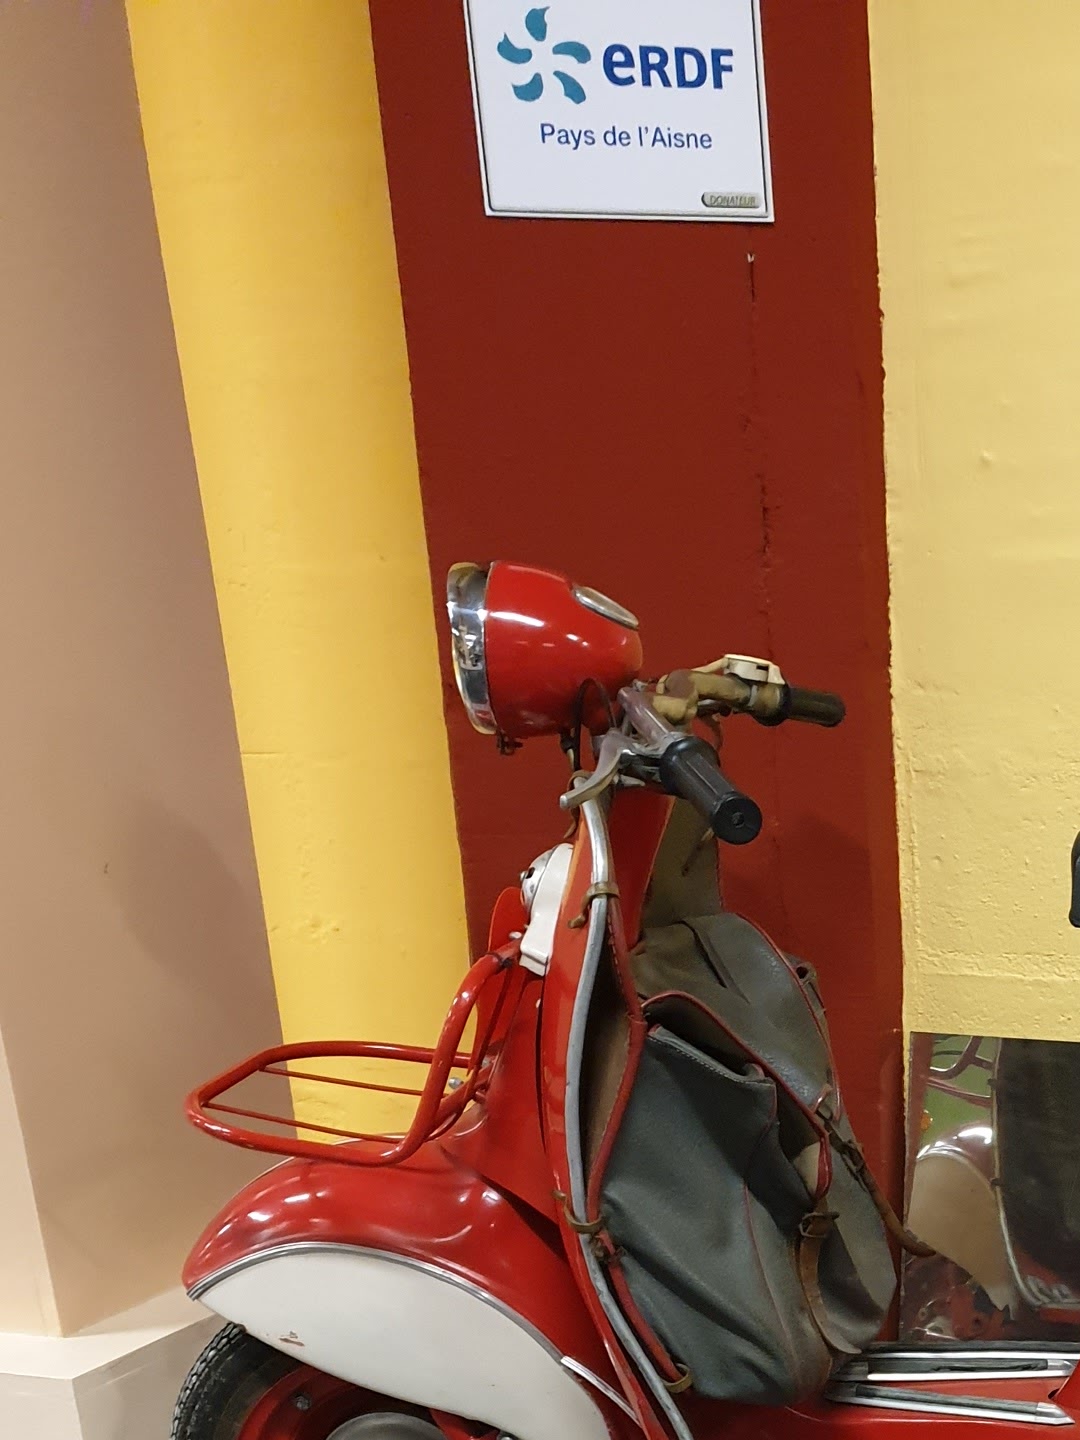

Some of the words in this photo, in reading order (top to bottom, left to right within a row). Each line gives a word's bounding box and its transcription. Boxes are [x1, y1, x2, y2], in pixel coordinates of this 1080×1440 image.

[540, 122, 596, 151] Pays
[602, 125, 631, 147] de
[638, 126, 713, 150] l'Aisne
